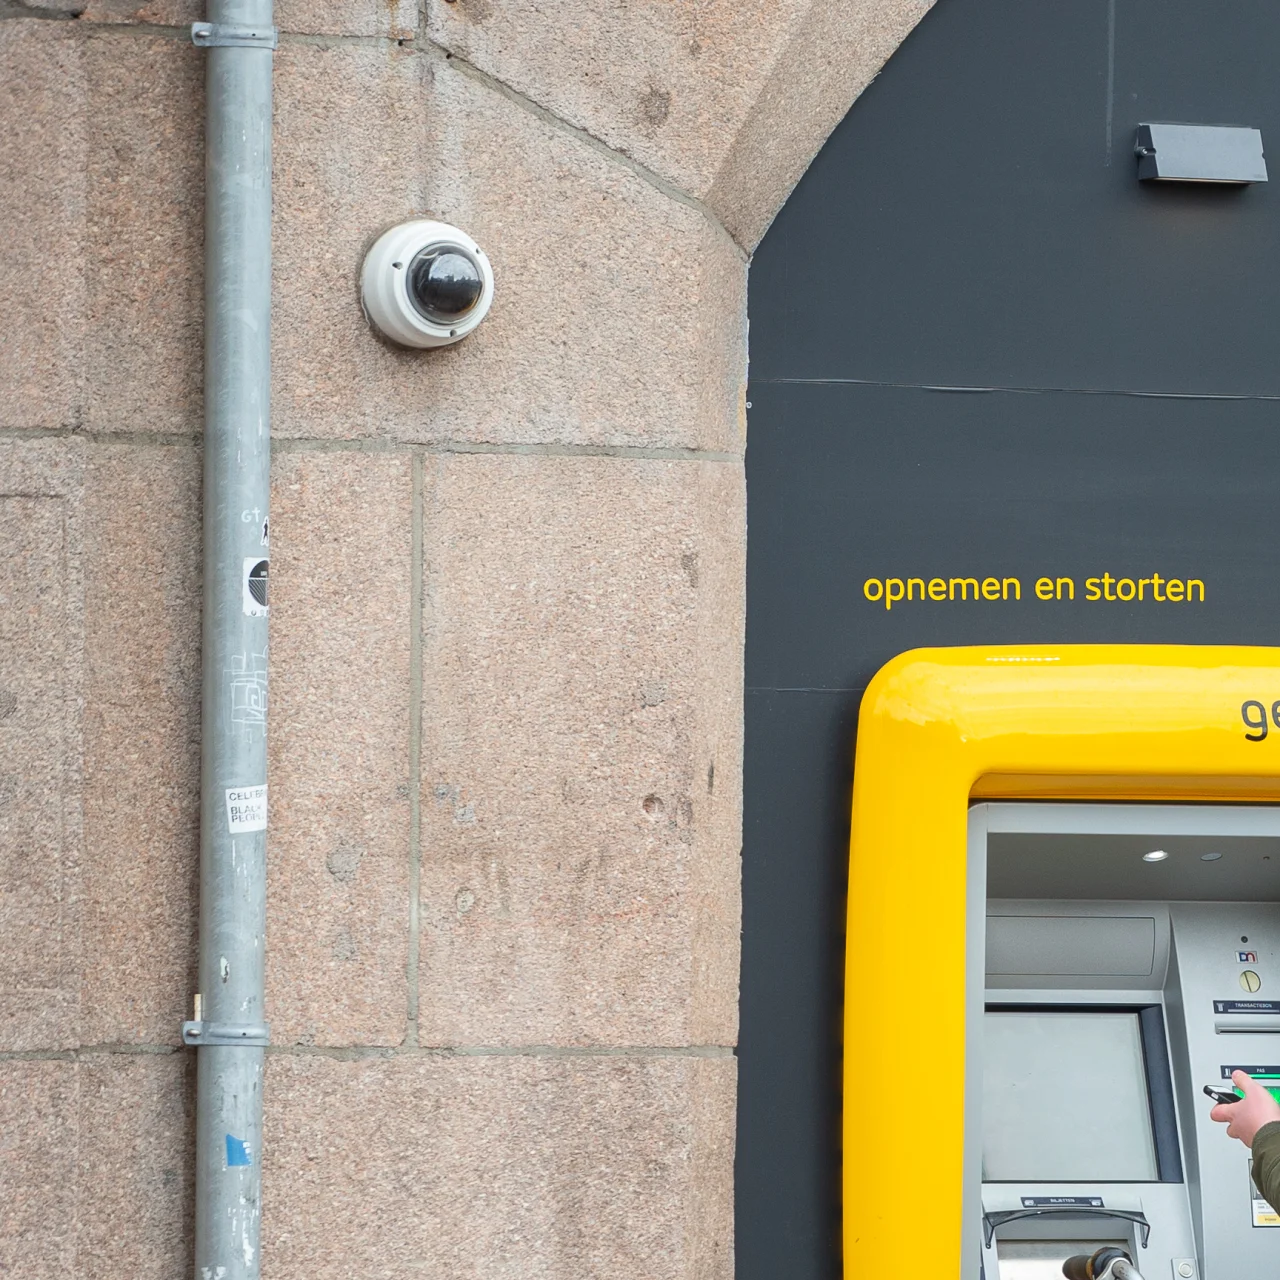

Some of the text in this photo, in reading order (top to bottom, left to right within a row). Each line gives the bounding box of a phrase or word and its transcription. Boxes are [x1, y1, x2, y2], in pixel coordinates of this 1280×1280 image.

[863, 572, 1205, 611] opnemen en storten
